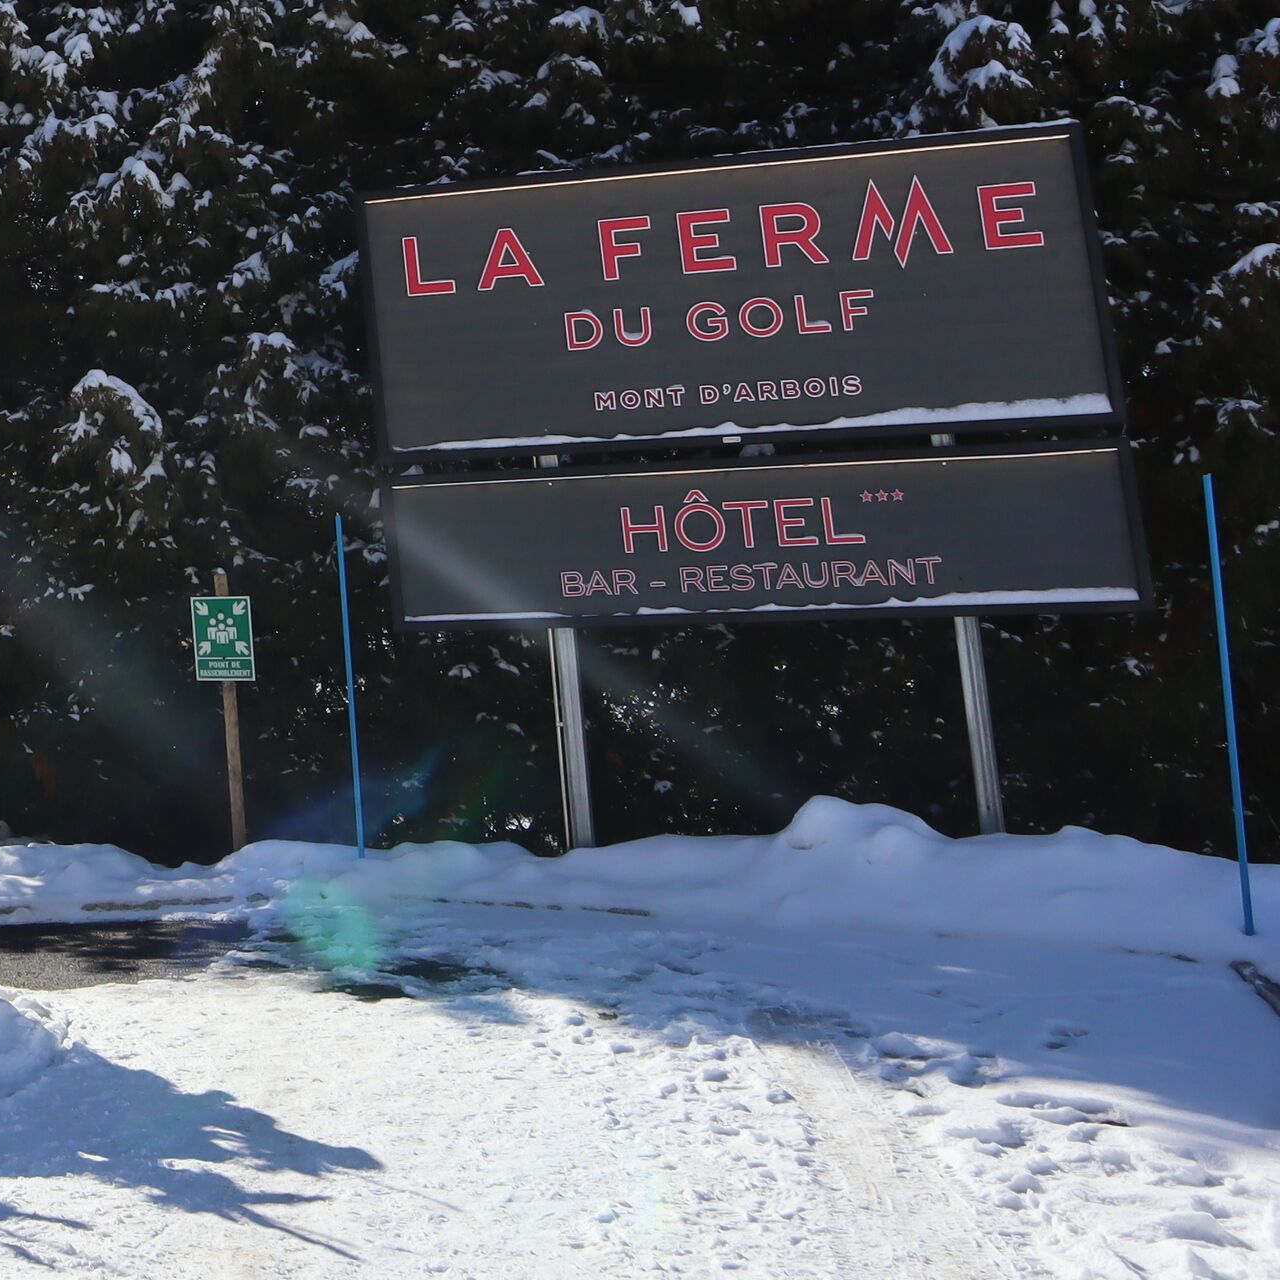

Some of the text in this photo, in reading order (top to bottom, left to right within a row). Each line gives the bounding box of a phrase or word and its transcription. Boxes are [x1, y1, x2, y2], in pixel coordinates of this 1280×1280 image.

[401, 174, 1045, 297] LA FERME
[564, 289, 874, 351] DU GOLF
[593, 375, 862, 411] MONT D'ARBOIS
[619, 489, 866, 554] HÔTEL
[559, 569, 639, 598] BAR
[678, 556, 942, 594] RESTAURANT
[208, 660, 241, 668] POINT DE
